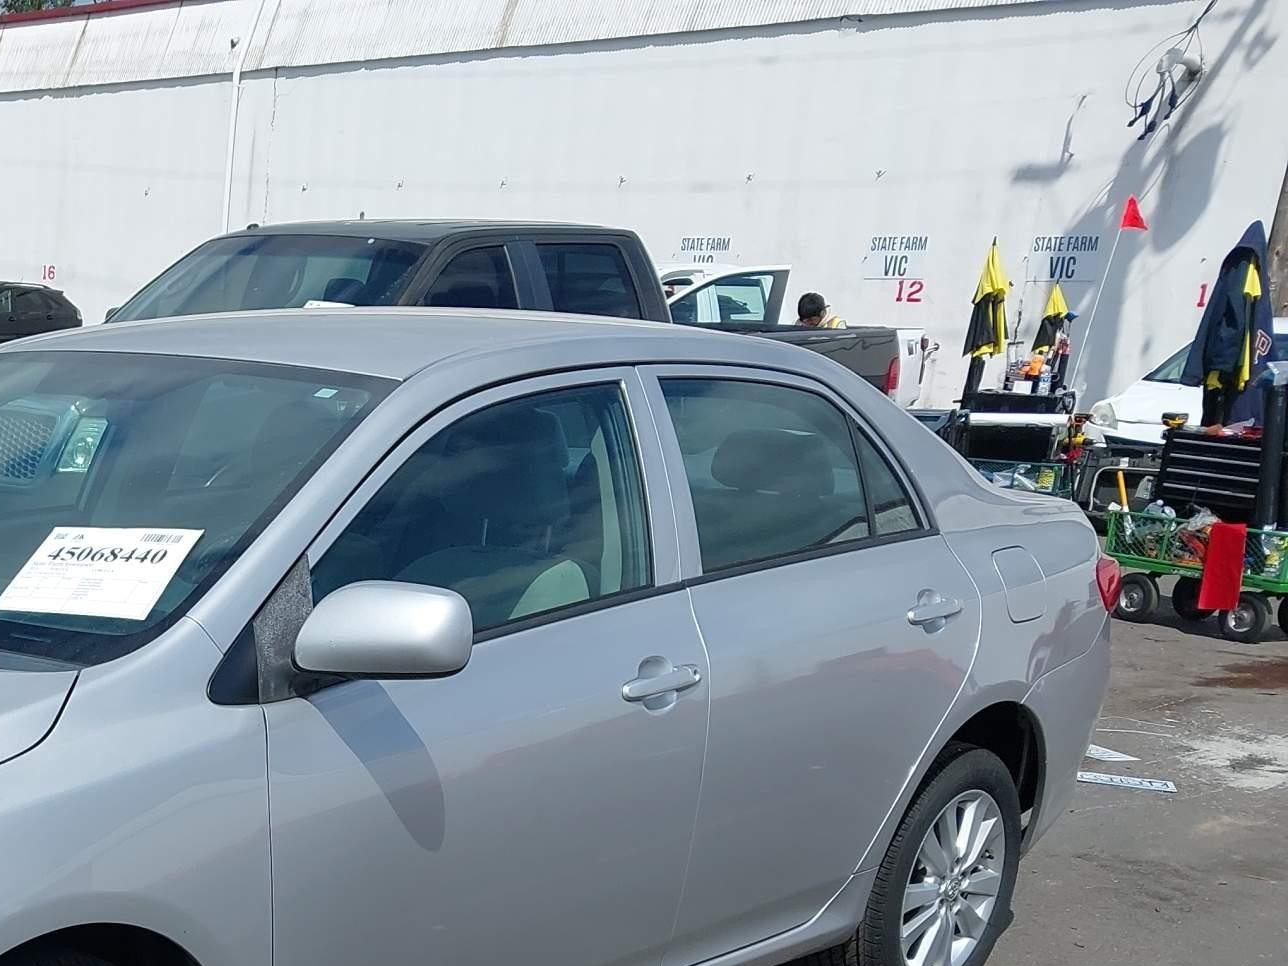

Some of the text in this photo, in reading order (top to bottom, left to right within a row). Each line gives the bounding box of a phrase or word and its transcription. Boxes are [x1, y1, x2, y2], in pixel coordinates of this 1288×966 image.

[681, 237, 731, 251] STATE FARM
[871, 236, 928, 251] STATE FARM
[1033, 236, 1099, 252] STATE FARM
[42, 265, 56, 280] 16
[884, 255, 908, 277] VIC
[1049, 256, 1077, 279] VIC
[896, 280, 924, 302] 12
[48, 546, 168, 565] 45068440
